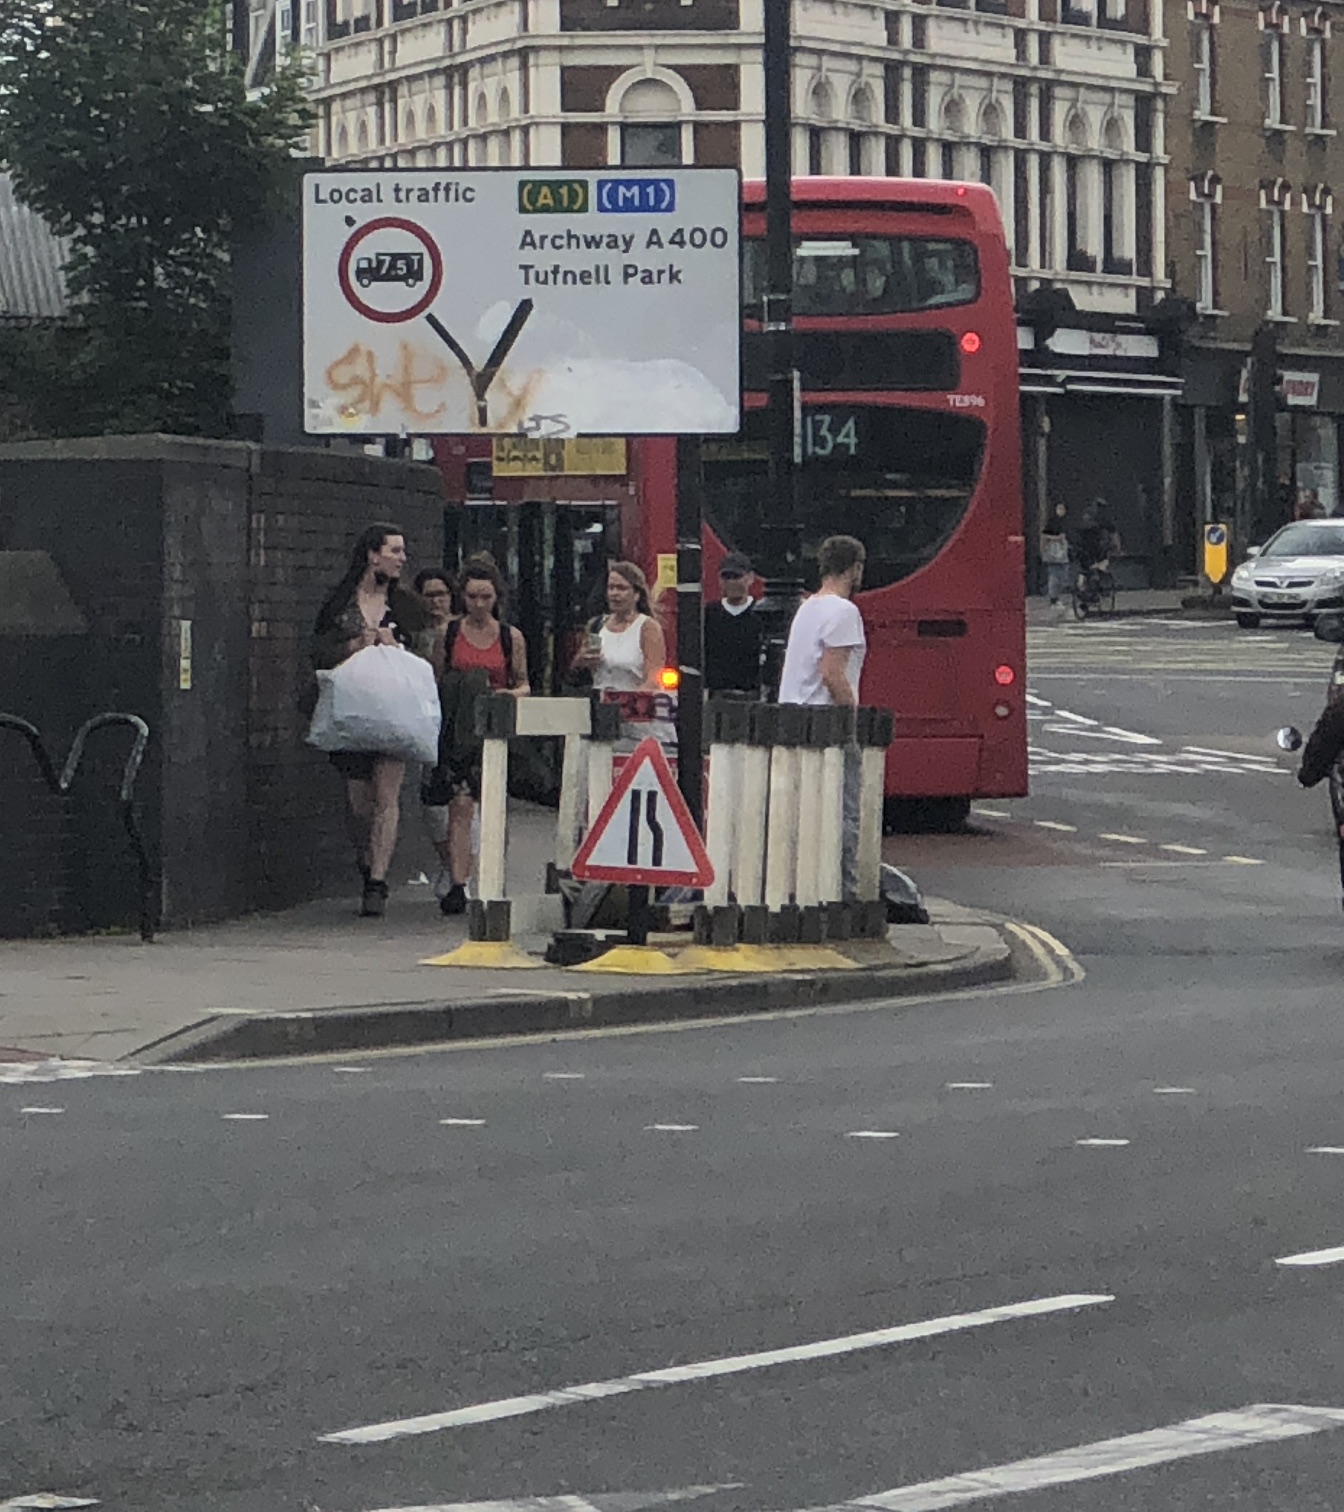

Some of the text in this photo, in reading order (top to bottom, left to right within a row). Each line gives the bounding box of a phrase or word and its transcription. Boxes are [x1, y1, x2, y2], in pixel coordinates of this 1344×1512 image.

[314, 182, 475, 204] Local traffic
[522, 183, 584, 211] (A1)
[602, 181, 671, 209] (M1)
[519, 226, 728, 253] Archway A400
[519, 264, 682, 286] Tufnell Park
[806, 414, 859, 456] 134
